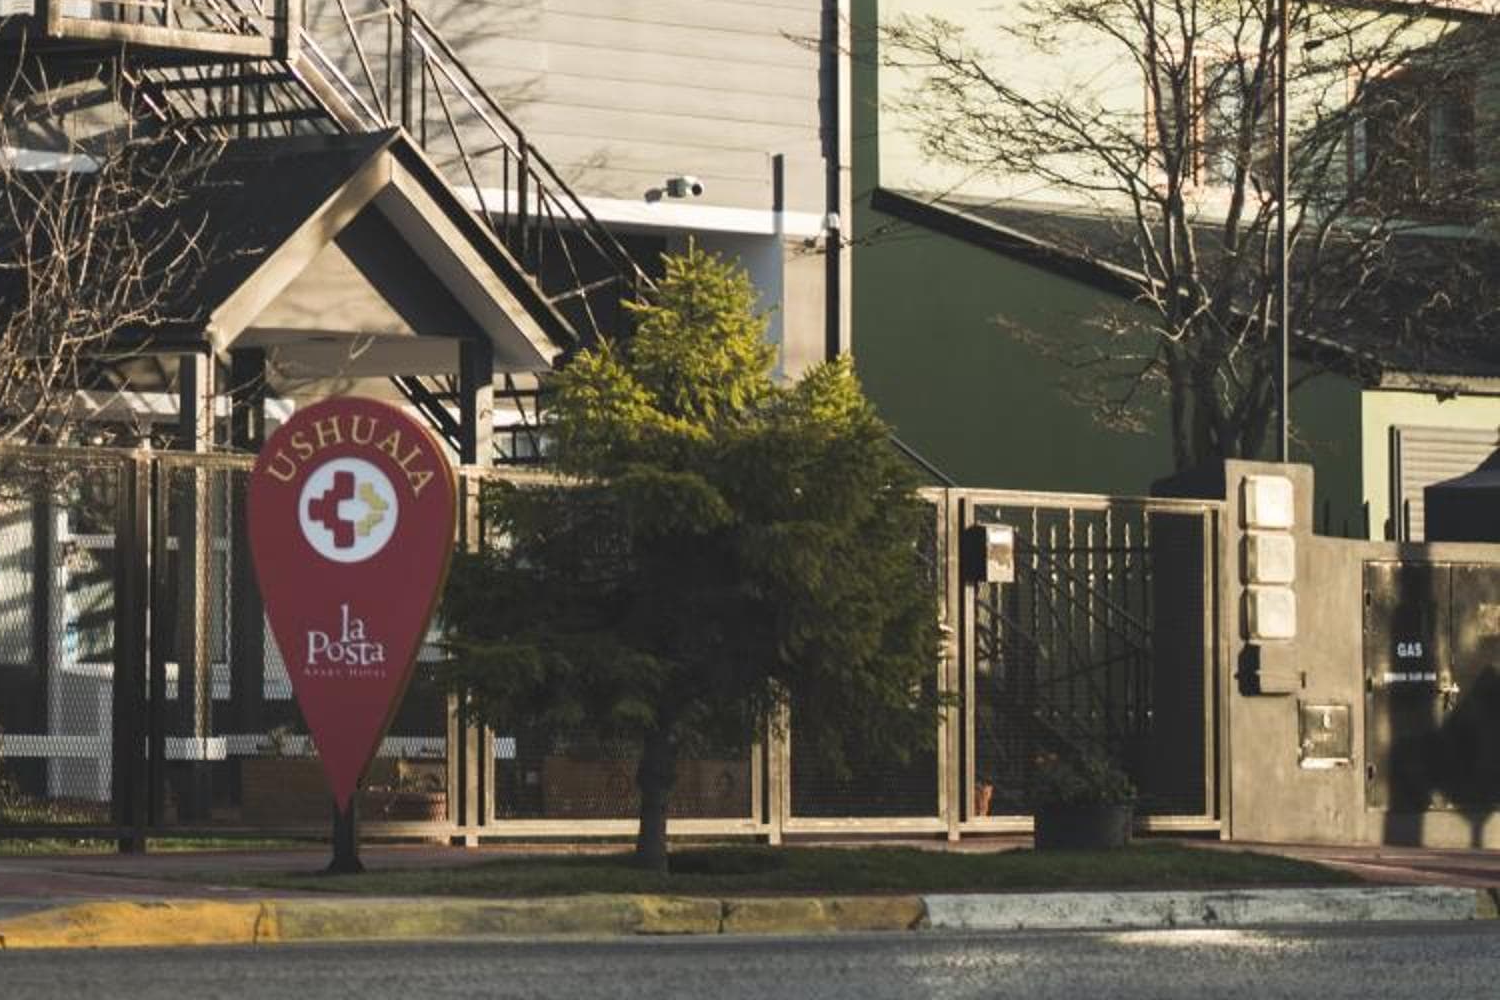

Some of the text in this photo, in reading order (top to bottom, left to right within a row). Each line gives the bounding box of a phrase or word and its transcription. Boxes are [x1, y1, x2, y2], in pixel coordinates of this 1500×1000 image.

[267, 415, 435, 497] USHUAIA
[340, 604, 365, 642] la
[307, 631, 385, 665] Posta
[1397, 642, 1423, 657] GAS
